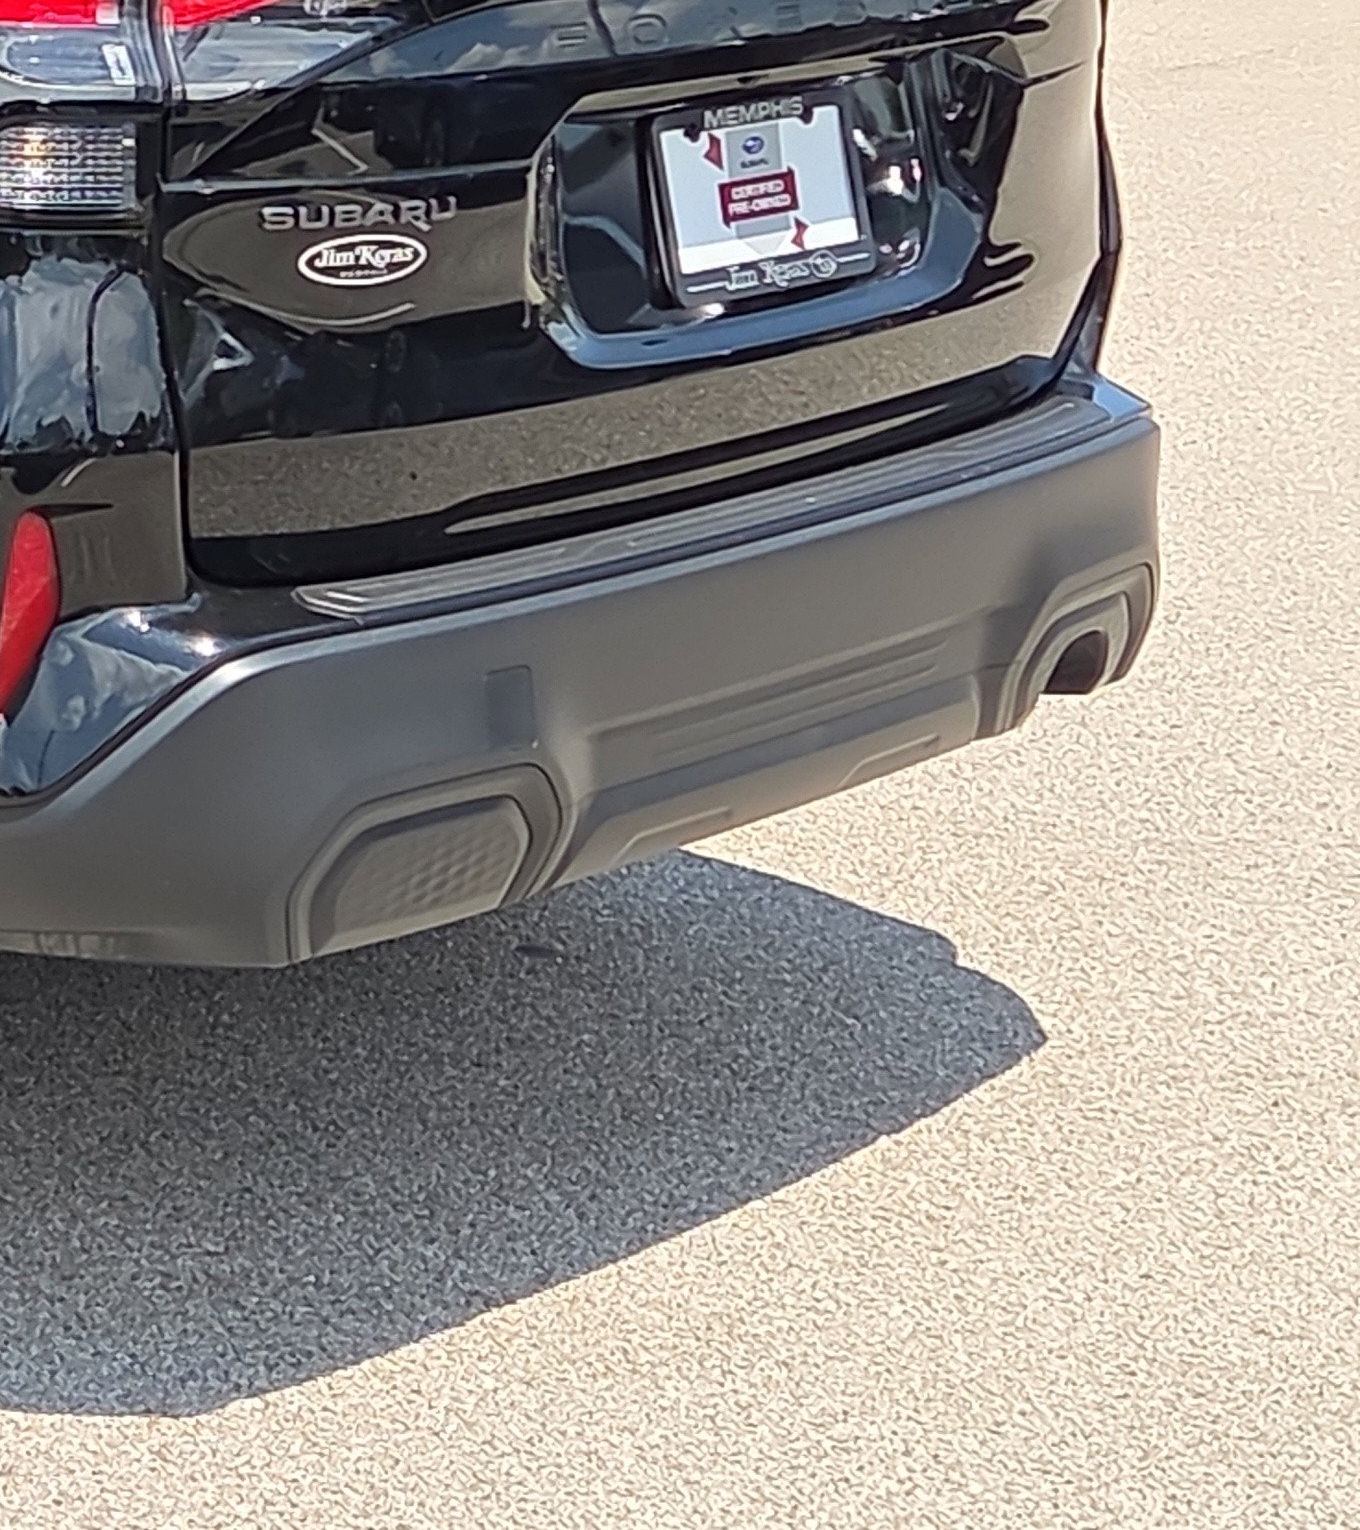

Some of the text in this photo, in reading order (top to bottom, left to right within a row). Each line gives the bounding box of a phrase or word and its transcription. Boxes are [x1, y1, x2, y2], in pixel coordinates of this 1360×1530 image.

[703, 96, 803, 129] MEMPHIS
[261, 195, 458, 232] SUBARU
[313, 245, 414, 268] Jim Keras
